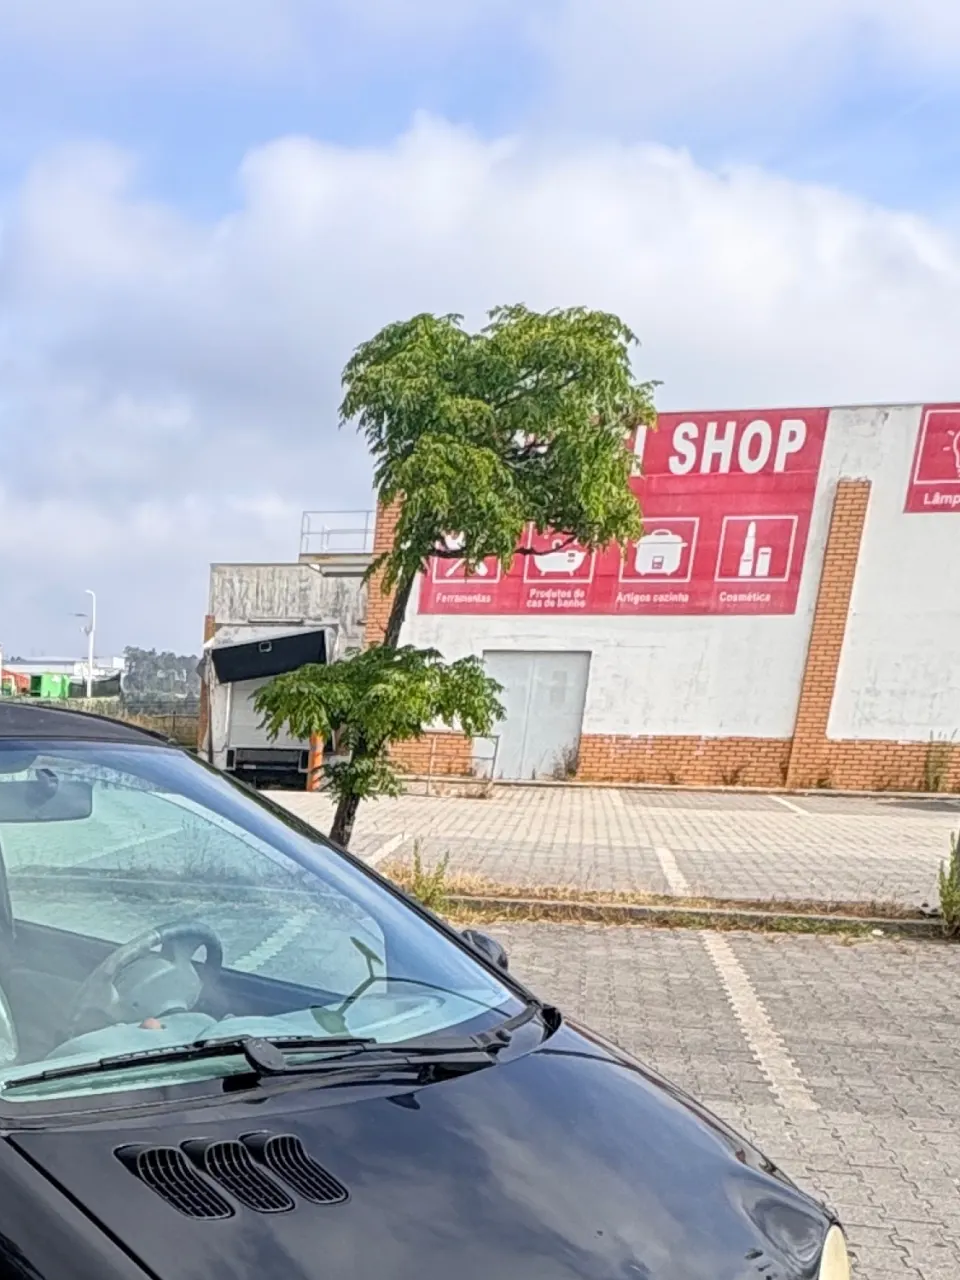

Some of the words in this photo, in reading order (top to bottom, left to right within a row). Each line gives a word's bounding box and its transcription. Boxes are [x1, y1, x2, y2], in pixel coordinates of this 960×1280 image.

[668, 419, 807, 475] SHOP
[436, 592, 491, 603] Ferramentas
[617, 591, 650, 605] Artigos
